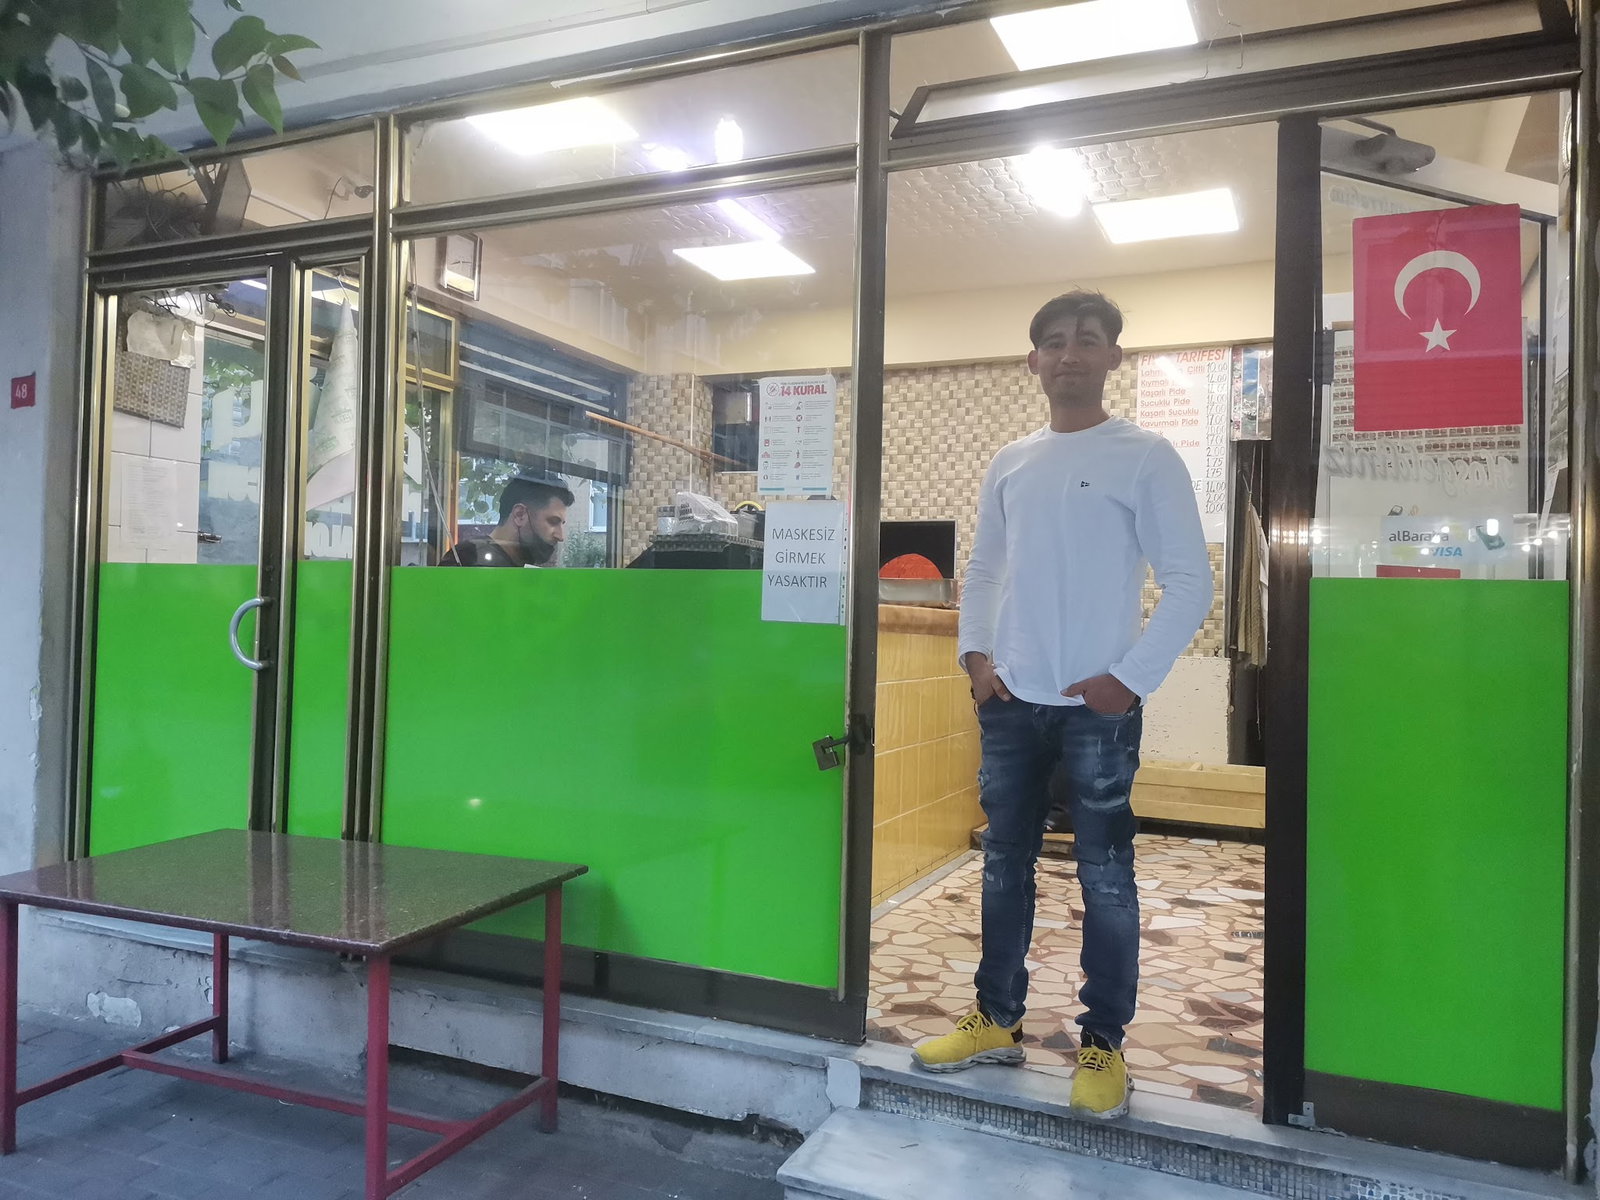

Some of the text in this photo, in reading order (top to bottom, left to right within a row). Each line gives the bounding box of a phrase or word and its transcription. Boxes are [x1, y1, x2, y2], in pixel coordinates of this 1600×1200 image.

[15, 383, 28, 399] 48
[781, 384, 827, 396] 14 KURAL
[1168, 387, 1187, 395] Pide
[1140, 398, 1171, 407] Sucuklu
[1173, 397, 1191, 405] Pide
[1168, 407, 1199, 416] Sucuklu
[1139, 418, 1179, 428] Kavurmalı
[1181, 418, 1199, 426] Pide
[1180, 439, 1200, 447] Pide
[772, 526, 836, 541] MASKESİZ
[775, 548, 826, 564] GİRMEK
[767, 574, 827, 588] YASAKTIR
